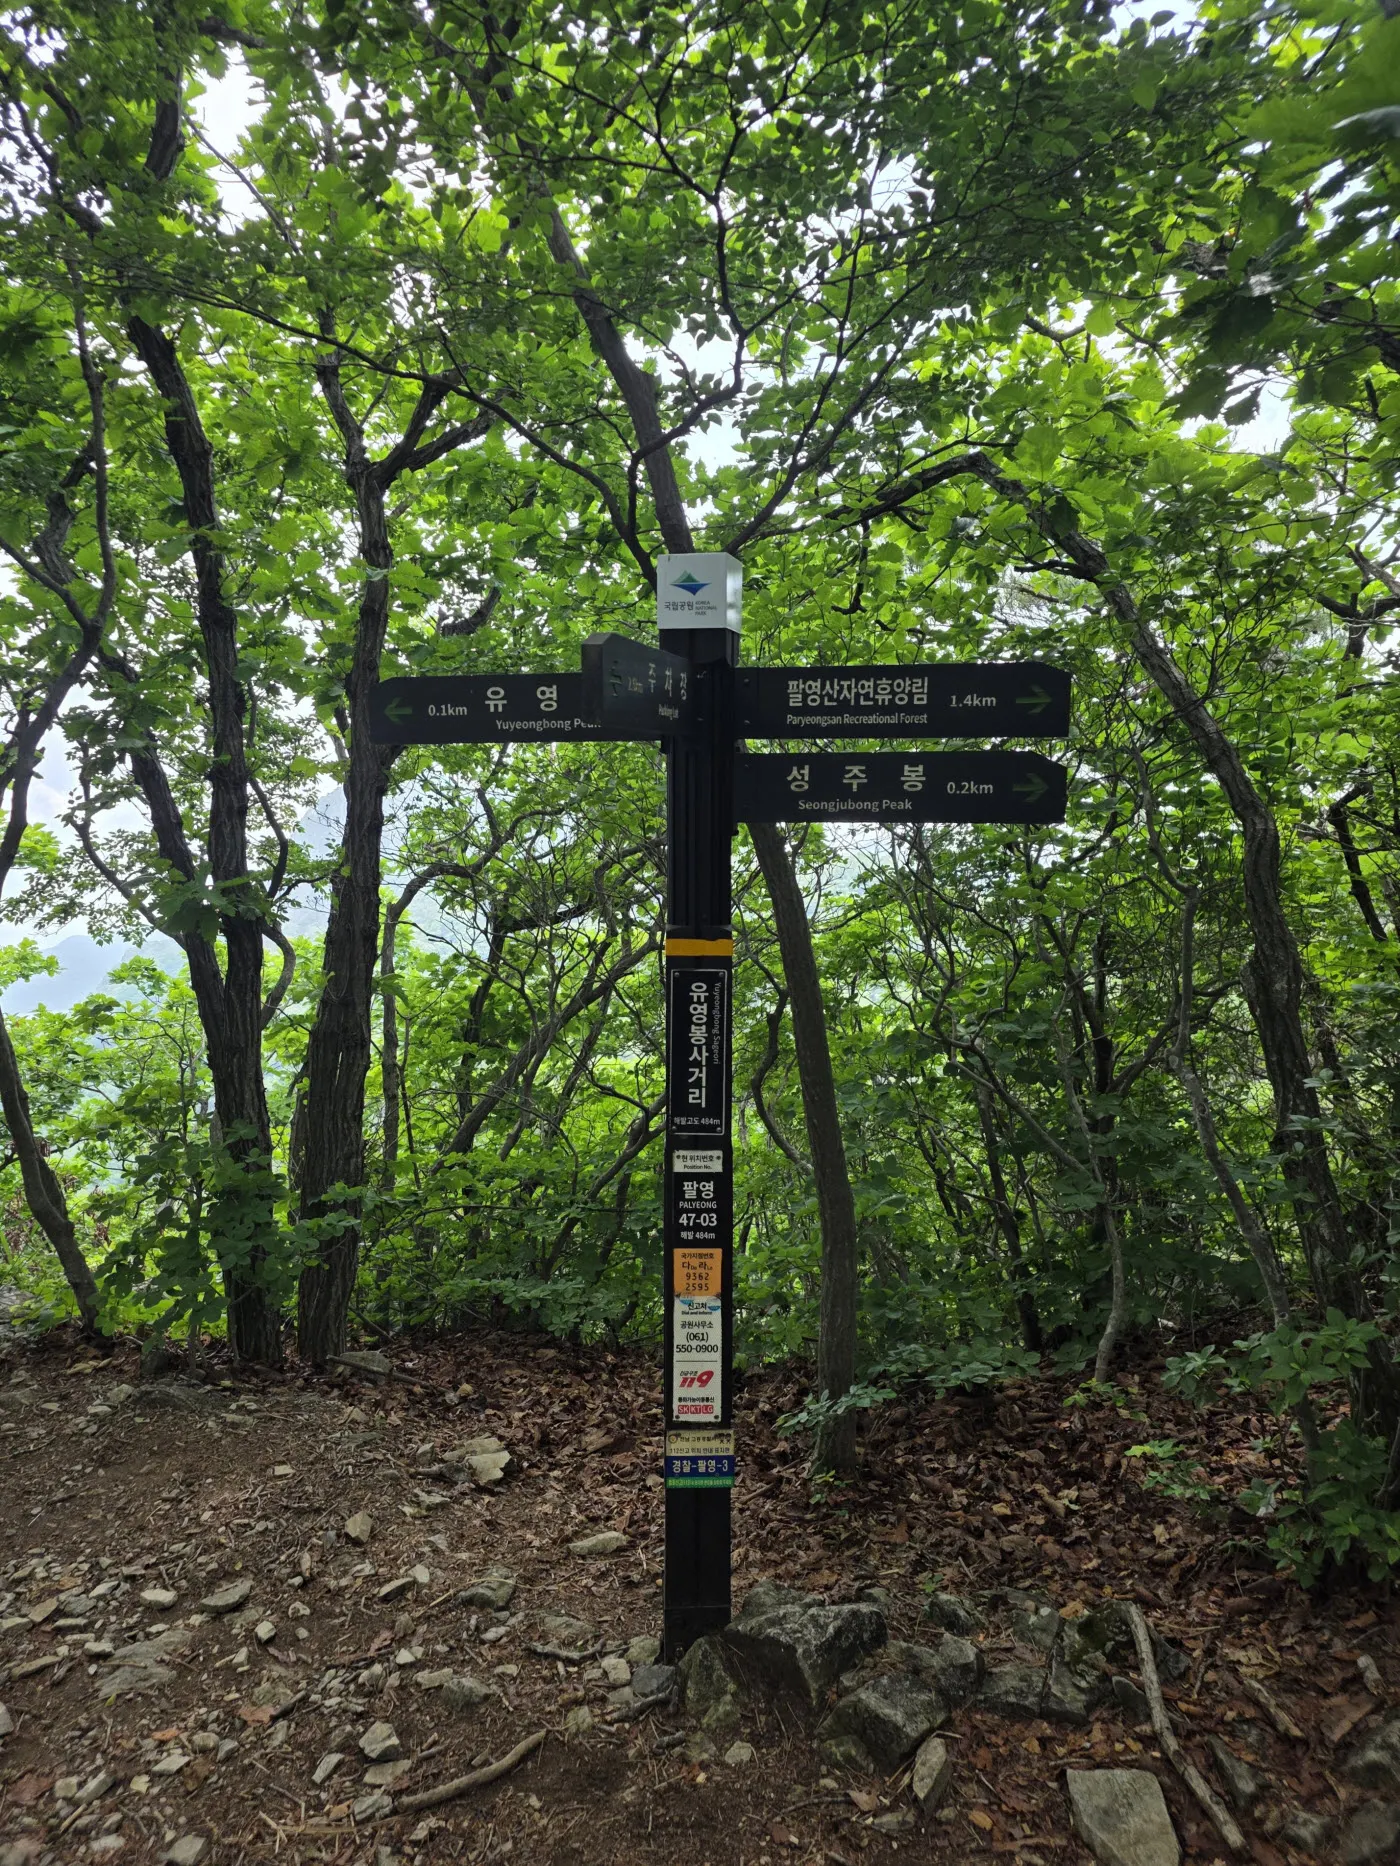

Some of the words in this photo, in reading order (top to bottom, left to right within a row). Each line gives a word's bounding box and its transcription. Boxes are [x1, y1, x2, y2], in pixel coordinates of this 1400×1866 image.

[664, 601, 694, 611] 국립공원
[787, 675, 929, 706] 팔영산자연휴양림
[949, 694, 996, 708] 1.4km
[428, 703, 468, 717] 0.1km
[496, 719, 571, 732] Yuyeongbong
[787, 713, 842, 727] Paryeongsan
[844, 713, 898, 725] Recreational
[900, 713, 928, 725] Forest
[947, 780, 994, 795] 0.2km
[798, 798, 880, 813] Seongjubong
[882, 798, 913, 810] Peak
[712, 982, 722, 1034] Yuyeongbong
[688, 982, 709, 1108] 유영봉사거리
[712, 1034, 722, 1064] Sageori
[674, 1116, 700, 1125] 해발고도
[700, 1117, 721, 1125] 484m
[682, 1154, 688, 1163] 현
[689, 1154, 714, 1163] 위치번호
[683, 1180, 714, 1199] 팔영
[679, 1201, 717, 1209] PALYEONG
[679, 1213, 717, 1227] 47-03
[680, 1231, 694, 1240] 해발
[695, 1231, 716, 1239] 484m
[685, 1272, 710, 1281] 9362
[685, 1283, 709, 1291] 2595
[688, 1301, 707, 1310] 신고처
[680, 1320, 714, 1329] 공원사무소
[686, 1331, 709, 1343] (061)
[675, 1344, 718, 1353] 550-0900
[679, 1370, 714, 1388] 119
[678, 1405, 689, 1413] SK
[690, 1405, 701, 1413] KT
[702, 1405, 713, 1413] LG
[672, 1459, 728, 1473] 경찰-팔영-3
